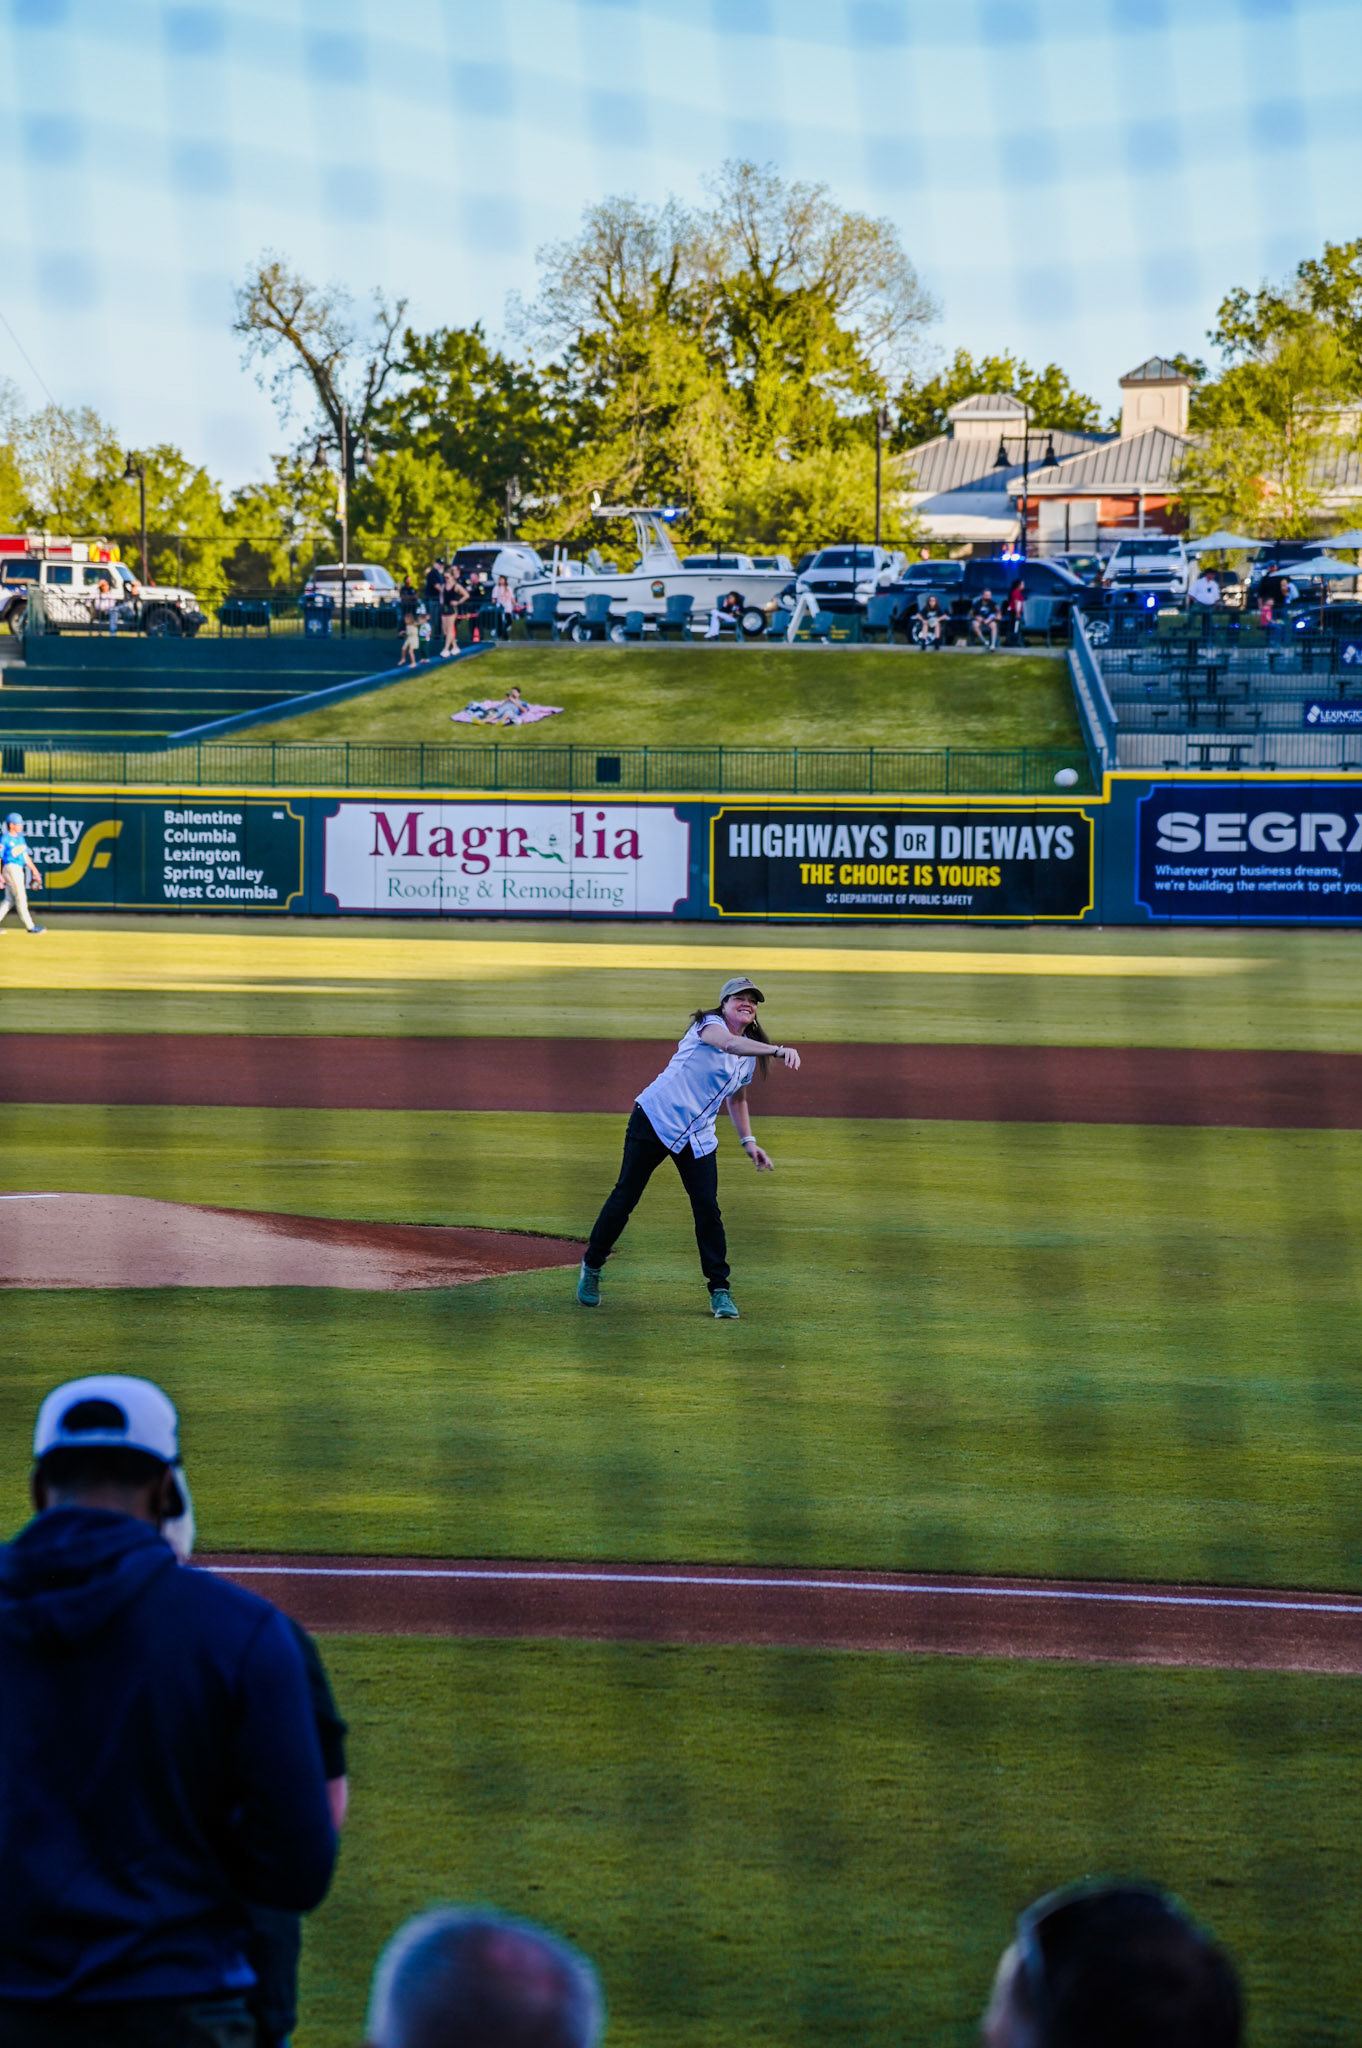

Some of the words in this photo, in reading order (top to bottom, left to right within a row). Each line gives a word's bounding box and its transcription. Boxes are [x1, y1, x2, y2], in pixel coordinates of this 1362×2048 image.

[164, 810, 242, 824] Ballentine
[164, 828, 237, 843] Columbia
[369, 811, 643, 875] Magnlia
[729, 823, 889, 859] HIGHWAYS
[903, 833, 927, 851] OR
[941, 825, 1075, 860] DIEWAYS
[164, 847, 241, 865] Lexington
[163, 865, 214, 883] Spring
[216, 866, 264, 884] Valley
[799, 863, 835, 885] THE
[839, 864, 910, 886] CHOICE
[914, 865, 933, 886] IS
[937, 865, 1001, 887] YOURS
[1155, 864, 1209, 877] Whatever
[1211, 866, 1237, 878] your
[1240, 864, 1292, 877] business
[1294, 865, 1342, 878] dreams,
[163, 884, 203, 898] West
[206, 884, 278, 899] Columbia
[387, 876, 469, 905] Roofing
[476, 879, 493, 898] &
[502, 878, 625, 907] Remodeling
[1155, 880, 1185, 891] we're
[1187, 880, 1234, 894] building
[1236, 880, 1254, 891] the
[1258, 880, 1304, 891] network
[1308, 881, 1320, 891] to
[1322, 881, 1341, 895] get
[826, 893, 838, 904] SC
[840, 893, 893, 905] DEPARTMENT
[895, 894, 907, 905] OF
[908, 894, 941, 905] PUBLIC
[942, 894, 973, 906] SAFETY
